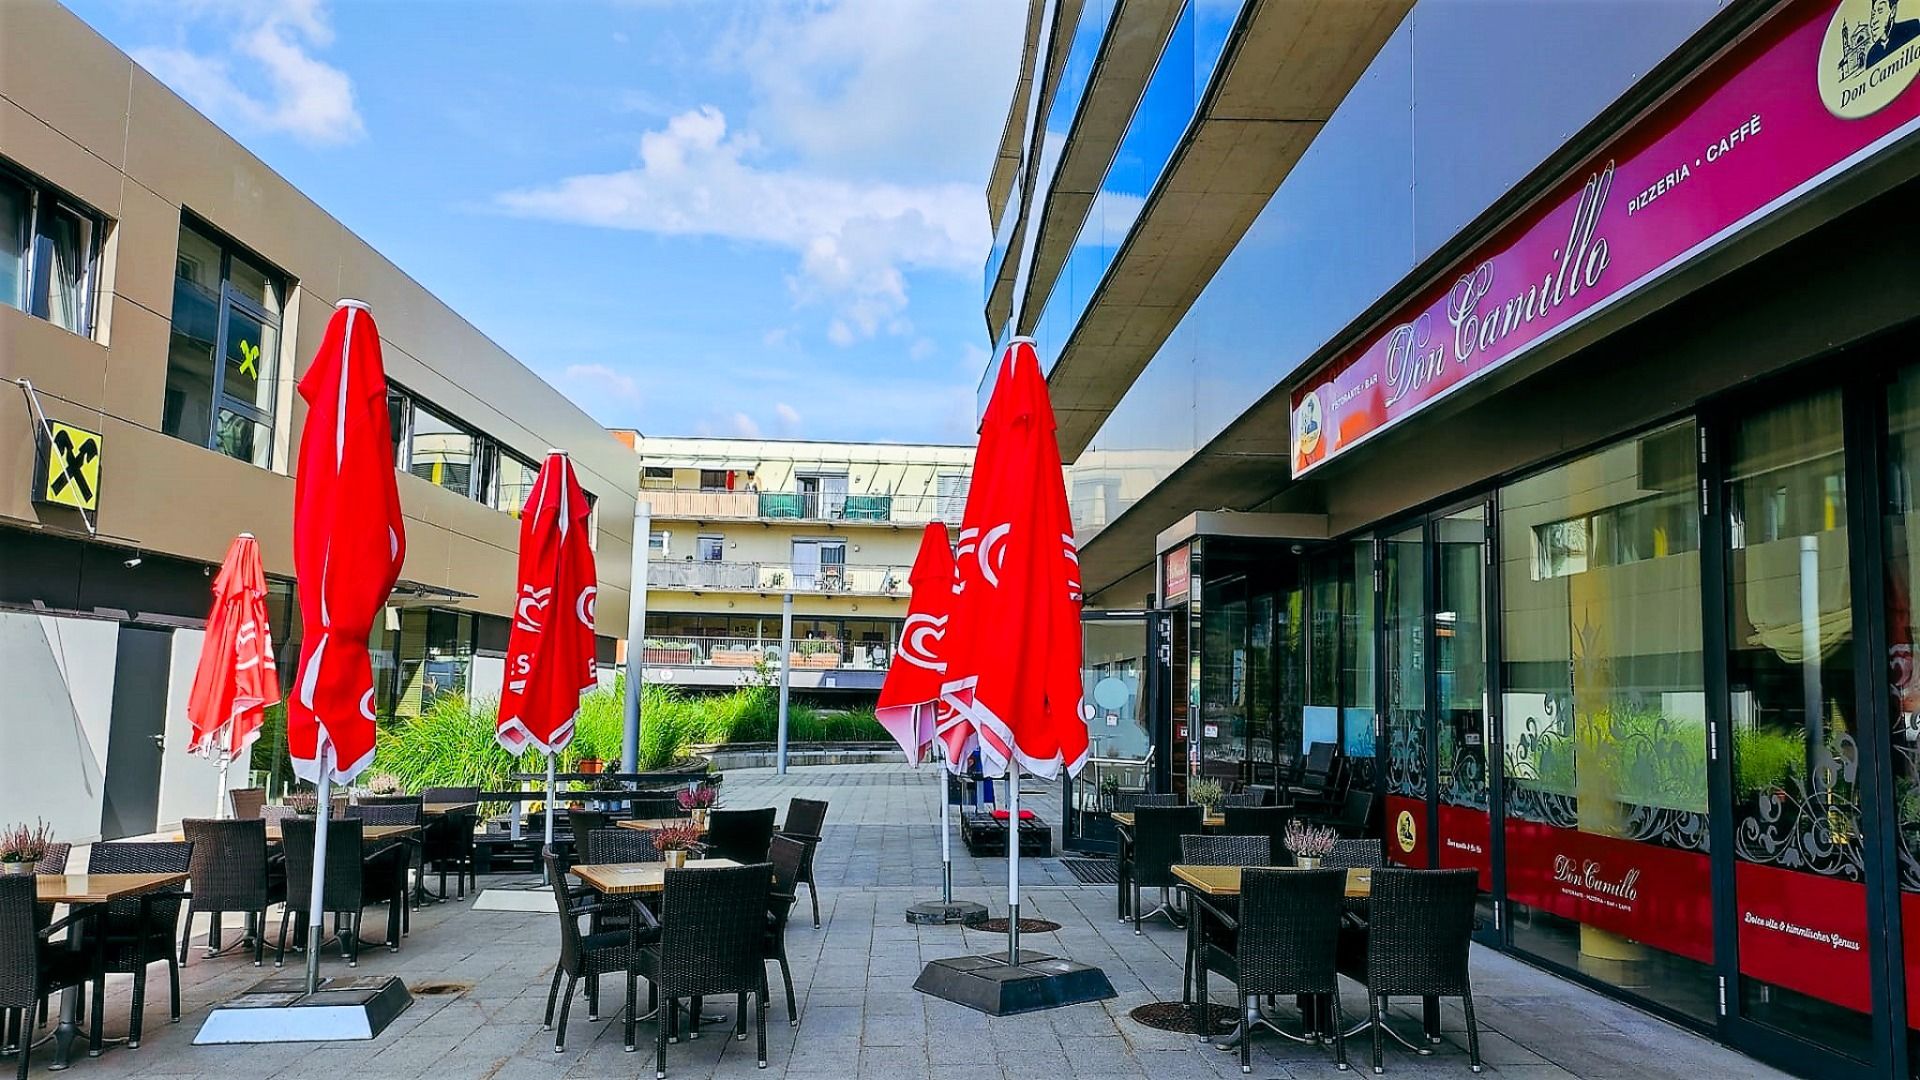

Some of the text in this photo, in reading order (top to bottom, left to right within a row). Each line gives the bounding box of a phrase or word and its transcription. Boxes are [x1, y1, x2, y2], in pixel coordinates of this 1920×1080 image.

[1840, 45, 1920, 109] Don Camillo
[1627, 114, 1762, 217] PIZZERIA CAFFÈ
[1384, 158, 1616, 408] Don Camillo
[1553, 854, 1640, 901] Don Camillo
[1744, 912, 1765, 926] Dolce
